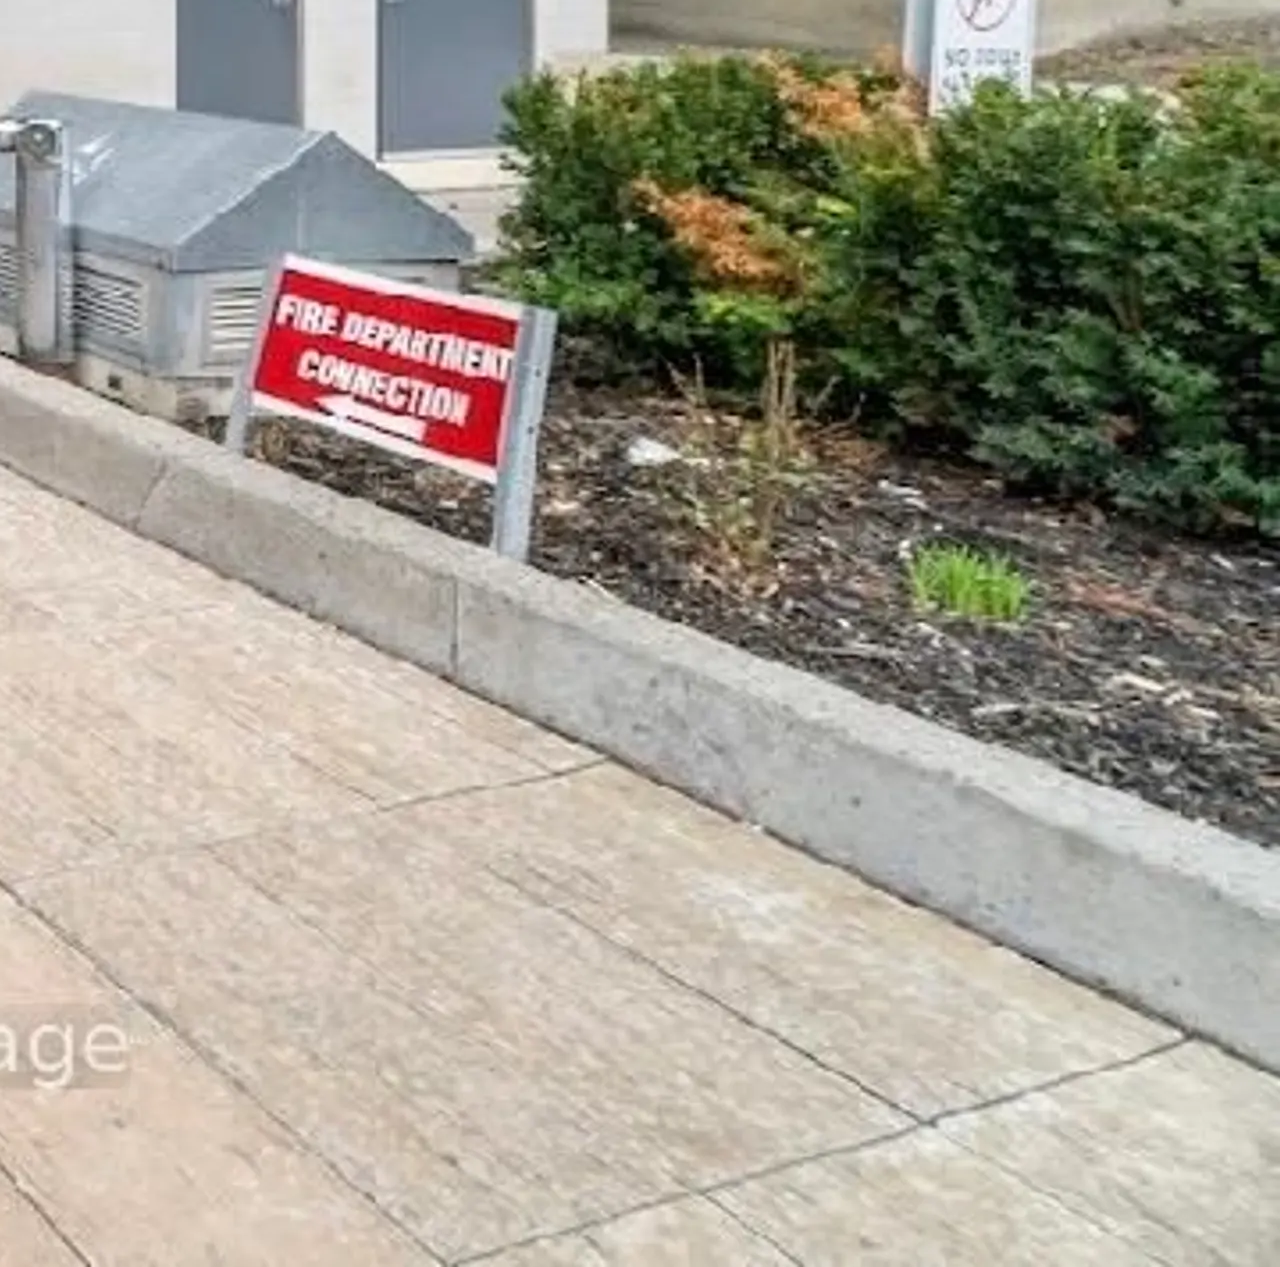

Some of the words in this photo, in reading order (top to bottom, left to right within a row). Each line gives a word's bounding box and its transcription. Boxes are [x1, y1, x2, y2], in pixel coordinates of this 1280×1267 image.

[276, 294, 339, 335] FIRE
[341, 311, 515, 381] DEPARTMENT
[296, 350, 471, 427] CONNECTION
